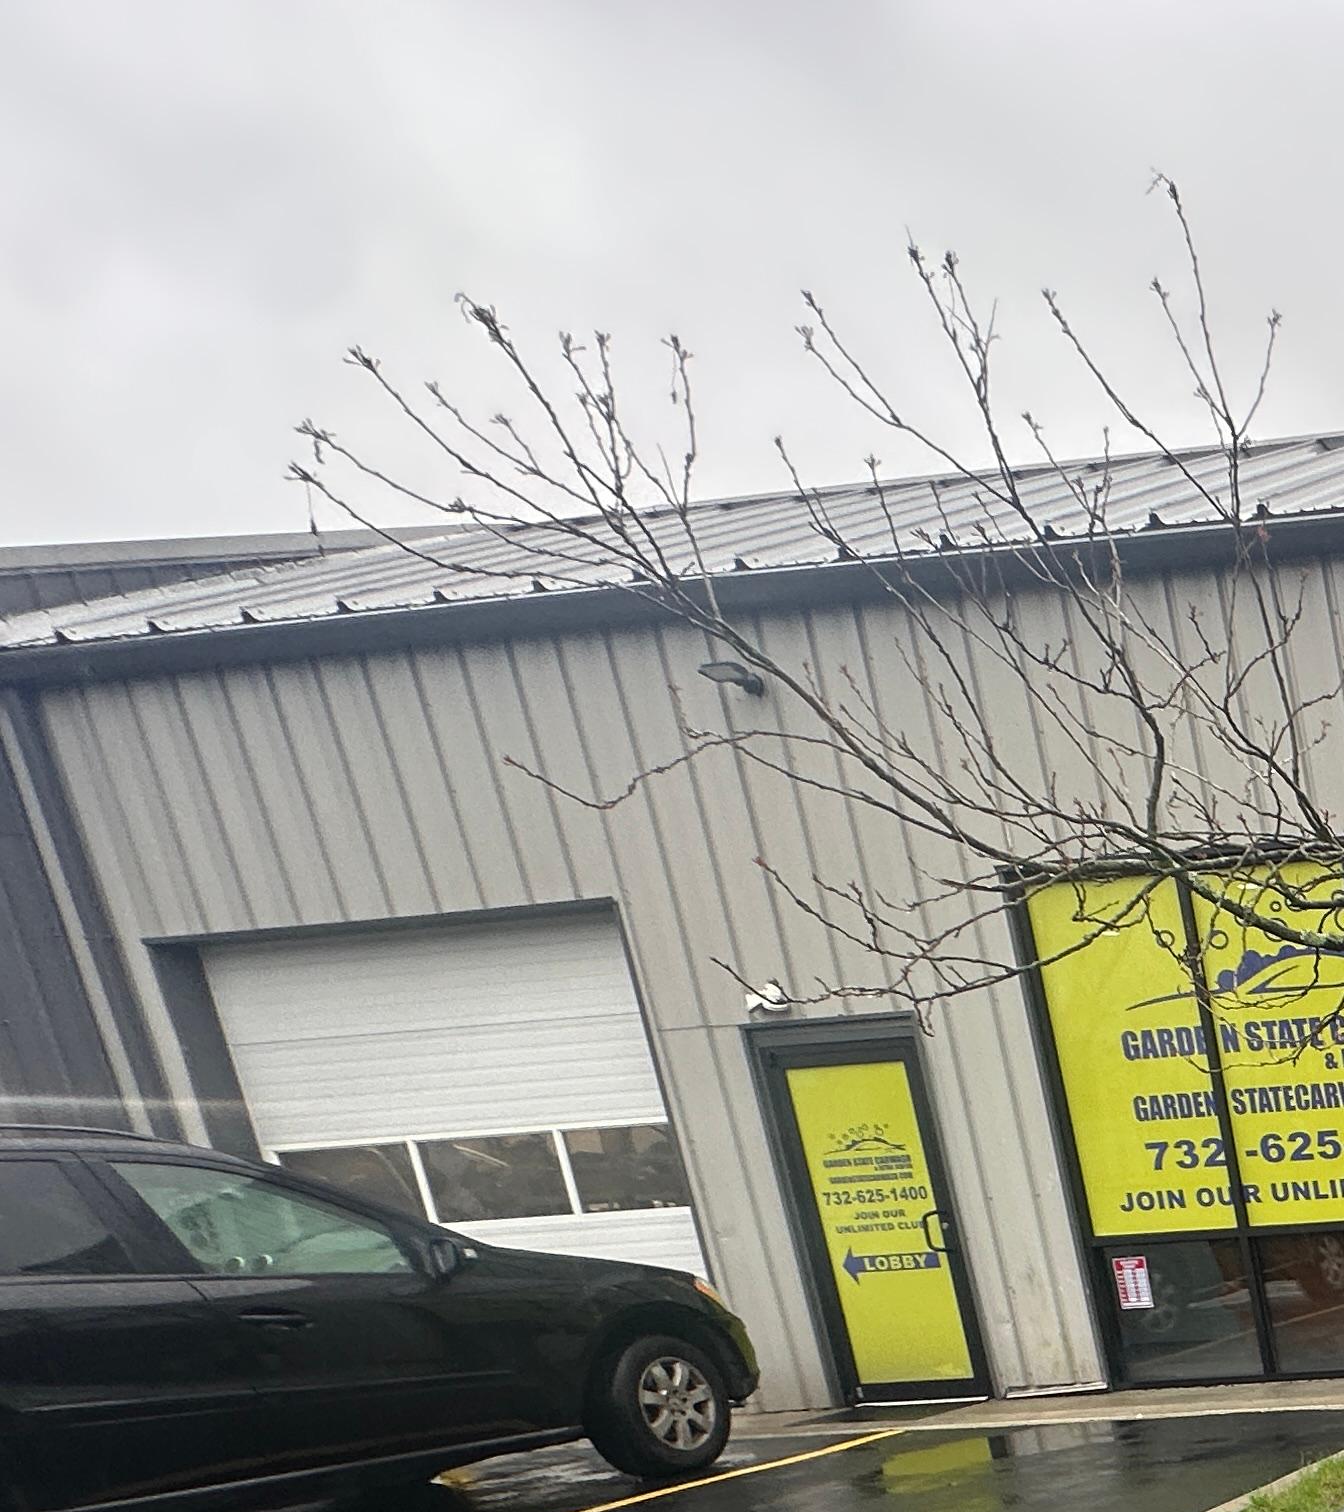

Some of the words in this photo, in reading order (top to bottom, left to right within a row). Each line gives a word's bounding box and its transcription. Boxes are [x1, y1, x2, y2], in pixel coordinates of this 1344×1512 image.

[1121, 1023, 1240, 1061] GARDEN
[1244, 1016, 1324, 1052] STATE
[1324, 1052, 1339, 1069] &
[822, 1186, 928, 1206] 732-625-1400
[1120, 1189, 1187, 1212] JOIN
[1196, 1184, 1263, 1207] OUR
[854, 1210, 881, 1220] JOIN
[883, 1208, 906, 1218] OUR
[836, 1222, 895, 1234] UNLIMITED
[863, 1254, 928, 1271] LOBBY
